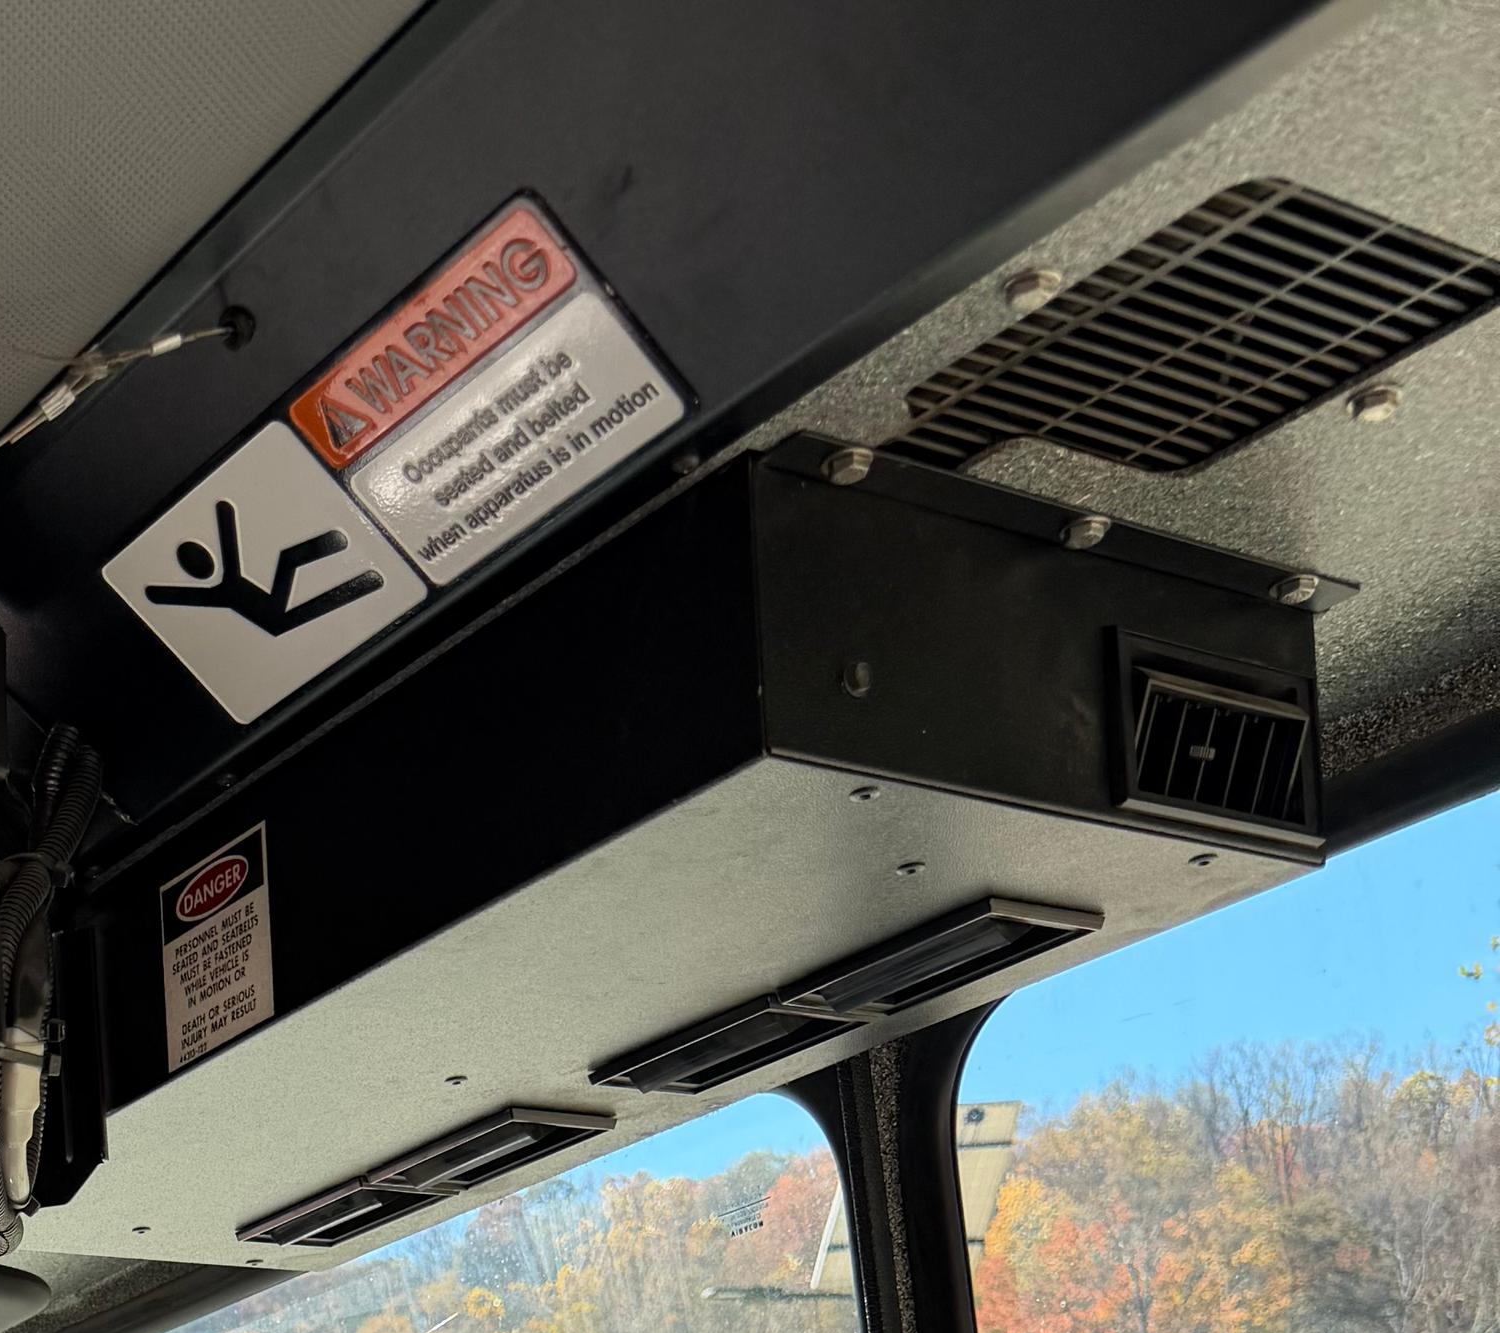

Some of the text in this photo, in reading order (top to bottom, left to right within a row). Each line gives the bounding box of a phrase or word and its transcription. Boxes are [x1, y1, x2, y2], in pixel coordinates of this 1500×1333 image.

[346, 237, 551, 415] WARNING
[402, 351, 573, 484] Occupants must be
[434, 382, 591, 507] seated and belted
[418, 381, 660, 562] when apparatus is in motion
[183, 864, 242, 915] DANGER
[172, 914, 258, 975] SEATED AND SEATBELTS
[175, 902, 254, 959] PERSONNEL MUST BE
[180, 934, 252, 985] MUST BE FASTENED
[184, 949, 249, 996] WHILE VEHICLE IS
[182, 984, 255, 1035] DEATH OR SERIOUS
[188, 966, 246, 1008] IN MOTION OR
[181, 998, 256, 1050] INJURY MAY RESULT
